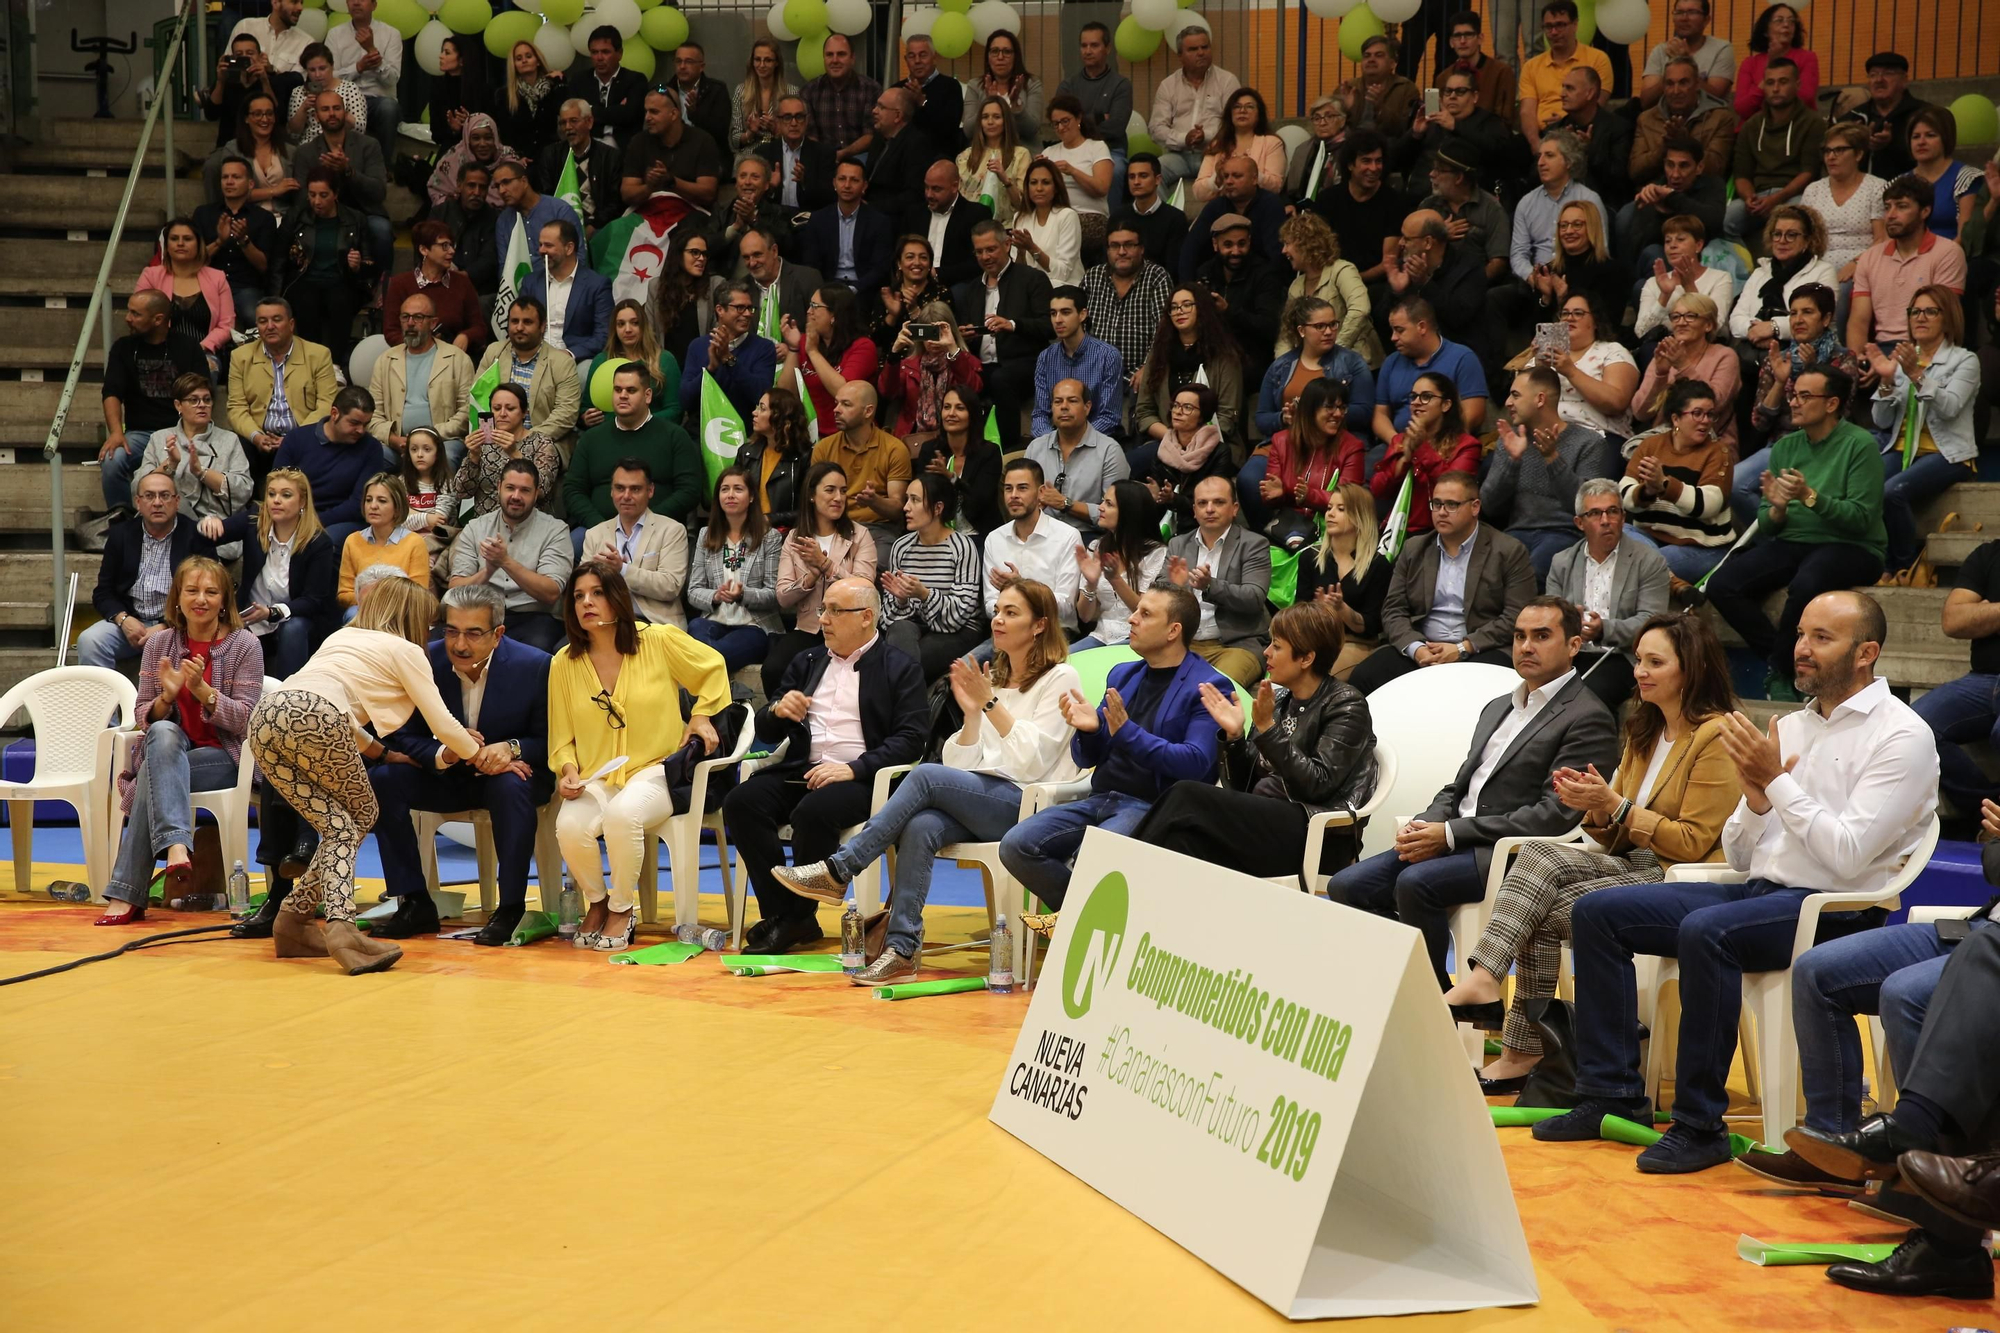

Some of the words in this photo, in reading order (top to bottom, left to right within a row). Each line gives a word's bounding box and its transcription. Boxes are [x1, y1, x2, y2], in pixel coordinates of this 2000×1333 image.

[409, 495, 420, 505] Be
[420, 494, 436, 506] Cool
[1126, 931, 1270, 1045] Comprometidos
[1261, 997, 1310, 1063] con
[1300, 1013, 1353, 1083] una
[1034, 1029, 1086, 1078] NUEVA
[1010, 1062, 1088, 1121] CANARIAS
[1255, 1094, 1322, 1182] 2019
